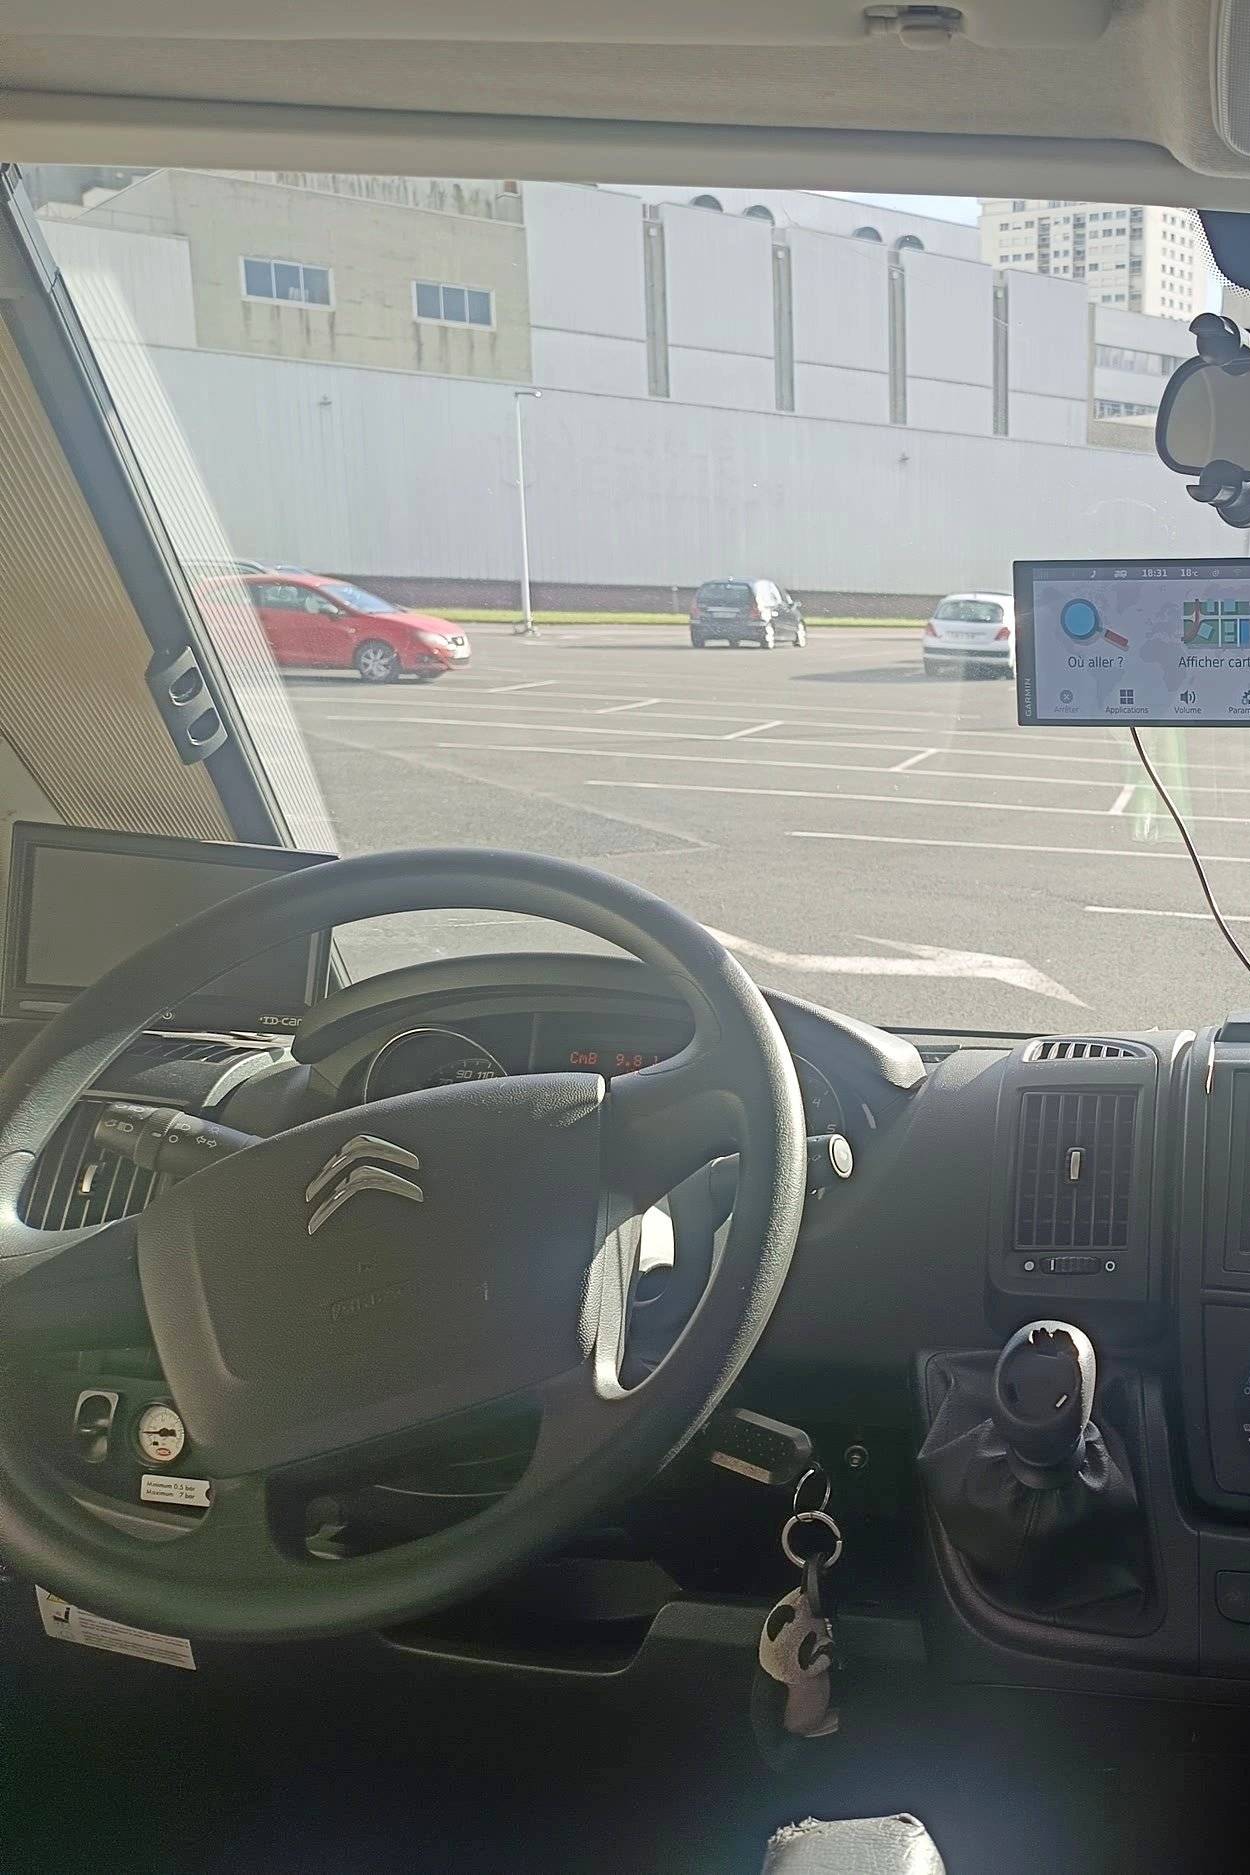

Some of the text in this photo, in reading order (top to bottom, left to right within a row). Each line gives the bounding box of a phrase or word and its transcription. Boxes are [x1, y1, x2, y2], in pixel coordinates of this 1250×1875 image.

[1141, 568, 1168, 578] 18:31
[1067, 656, 1124, 669] Où aller ?
[1178, 656, 1226, 669] Afficher
[1024, 677, 1032, 718] GARMIN
[1105, 705, 1150, 716] Applications
[1174, 705, 1202, 715] Volume
[456, 1069, 494, 1080] 90 110
[812, 1098, 821, 1108] 4
[826, 1123, 837, 1134] 5
